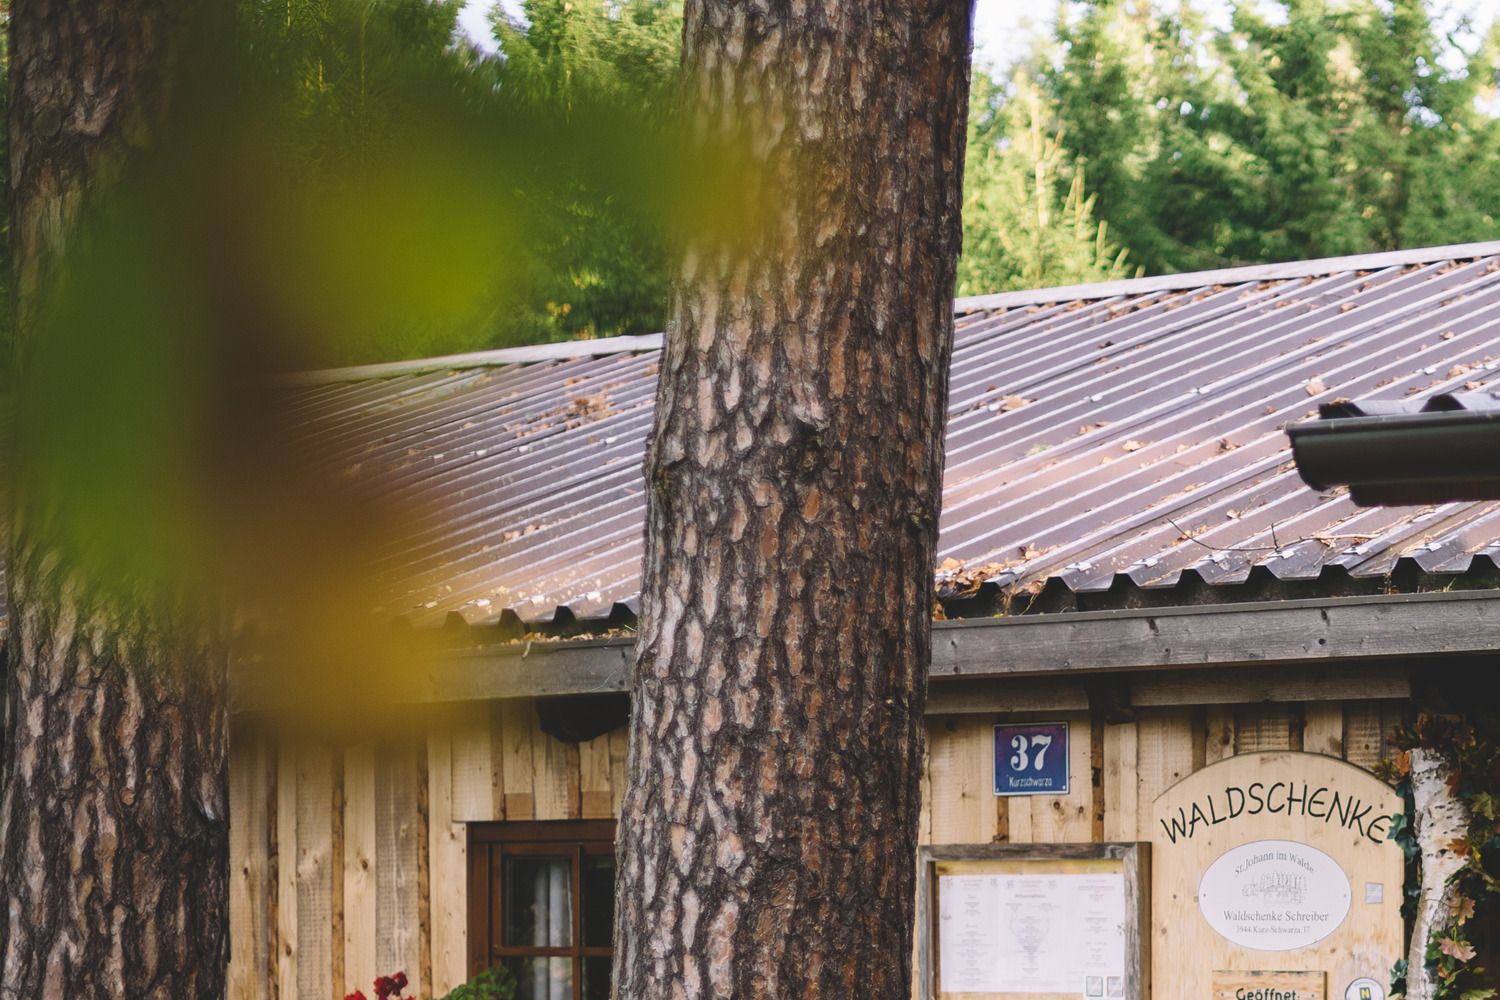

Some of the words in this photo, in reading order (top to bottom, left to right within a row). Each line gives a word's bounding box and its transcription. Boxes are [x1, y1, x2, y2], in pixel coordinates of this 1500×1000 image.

[1010, 734, 1052, 771] 37
[1008, 776, 1053, 787] Kurzschwarza
[1160, 782, 1393, 844] WALDSCHENKE
[1276, 850, 1287, 860] im
[1289, 852, 1314, 873] Walde
[1223, 910, 1283, 922] Waldschenke
[1286, 910, 1329, 922] Schreiber
